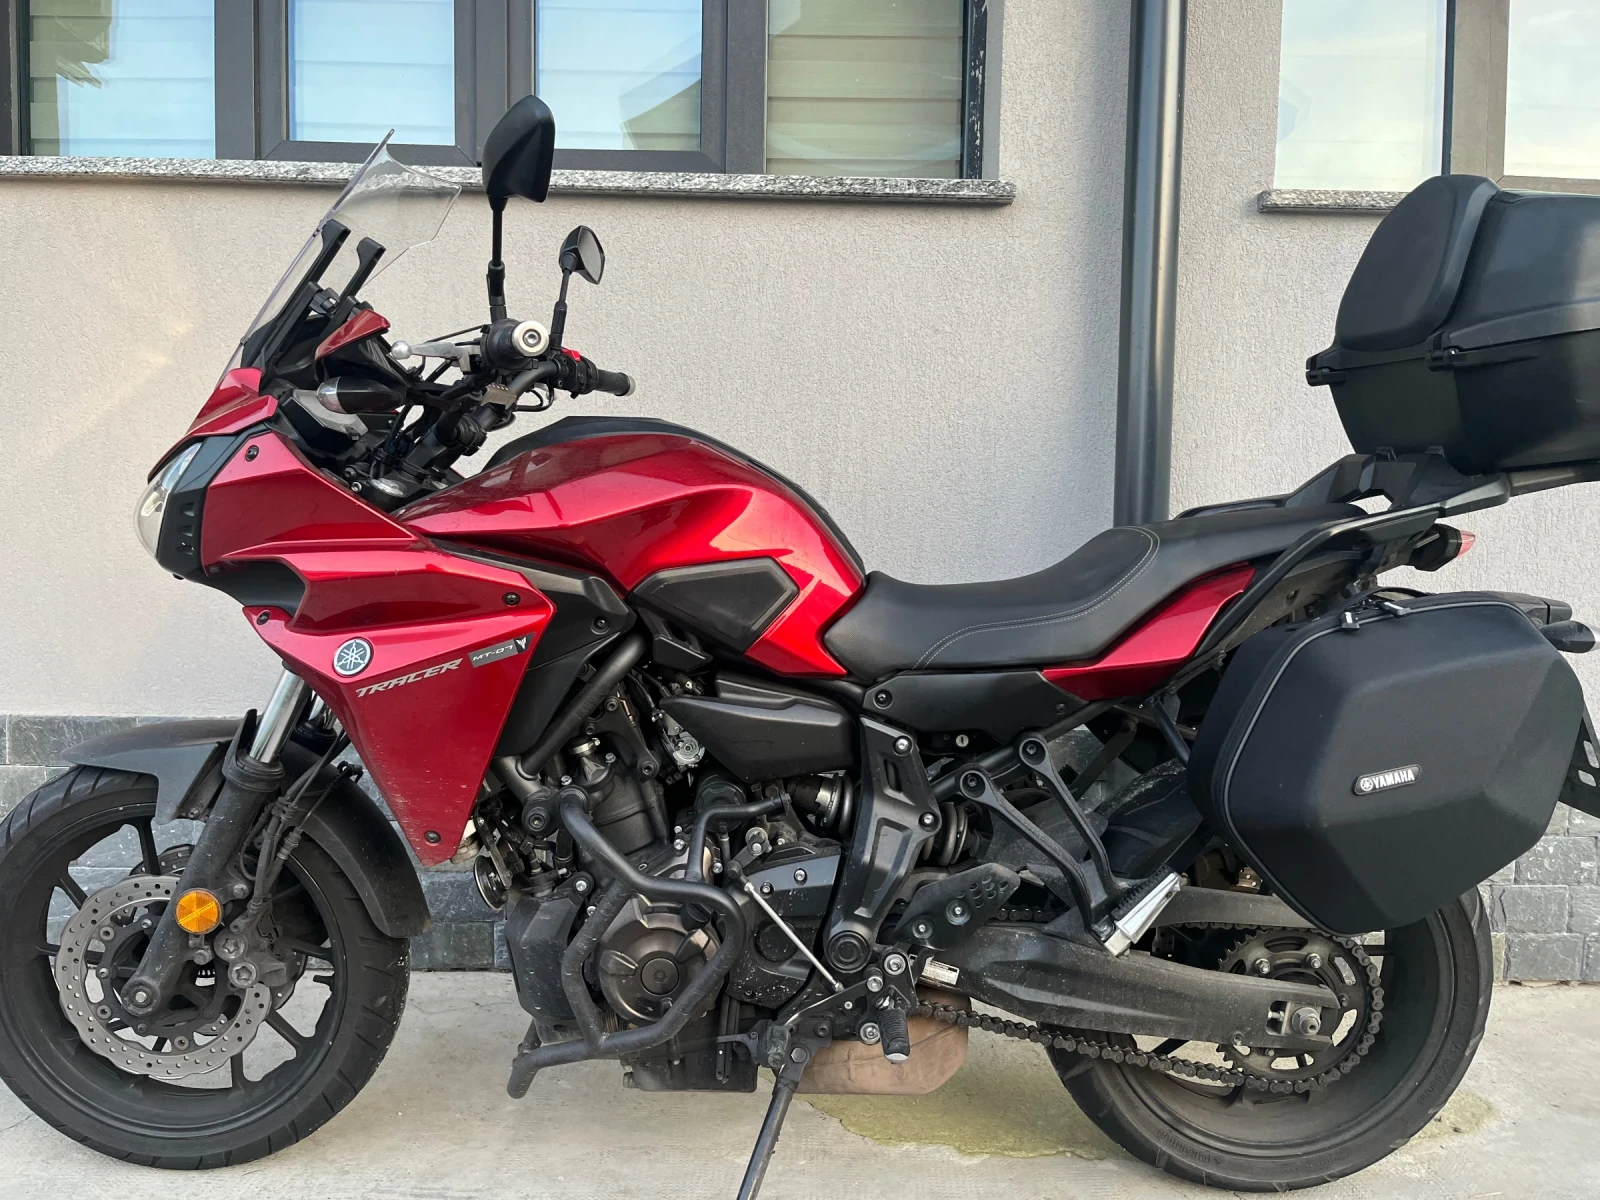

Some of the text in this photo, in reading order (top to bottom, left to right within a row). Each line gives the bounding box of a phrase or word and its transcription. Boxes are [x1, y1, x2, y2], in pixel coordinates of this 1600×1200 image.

[472, 644, 514, 661] MT-07
[355, 657, 464, 698] TRACER
[1372, 769, 1415, 789] YAMAHA
